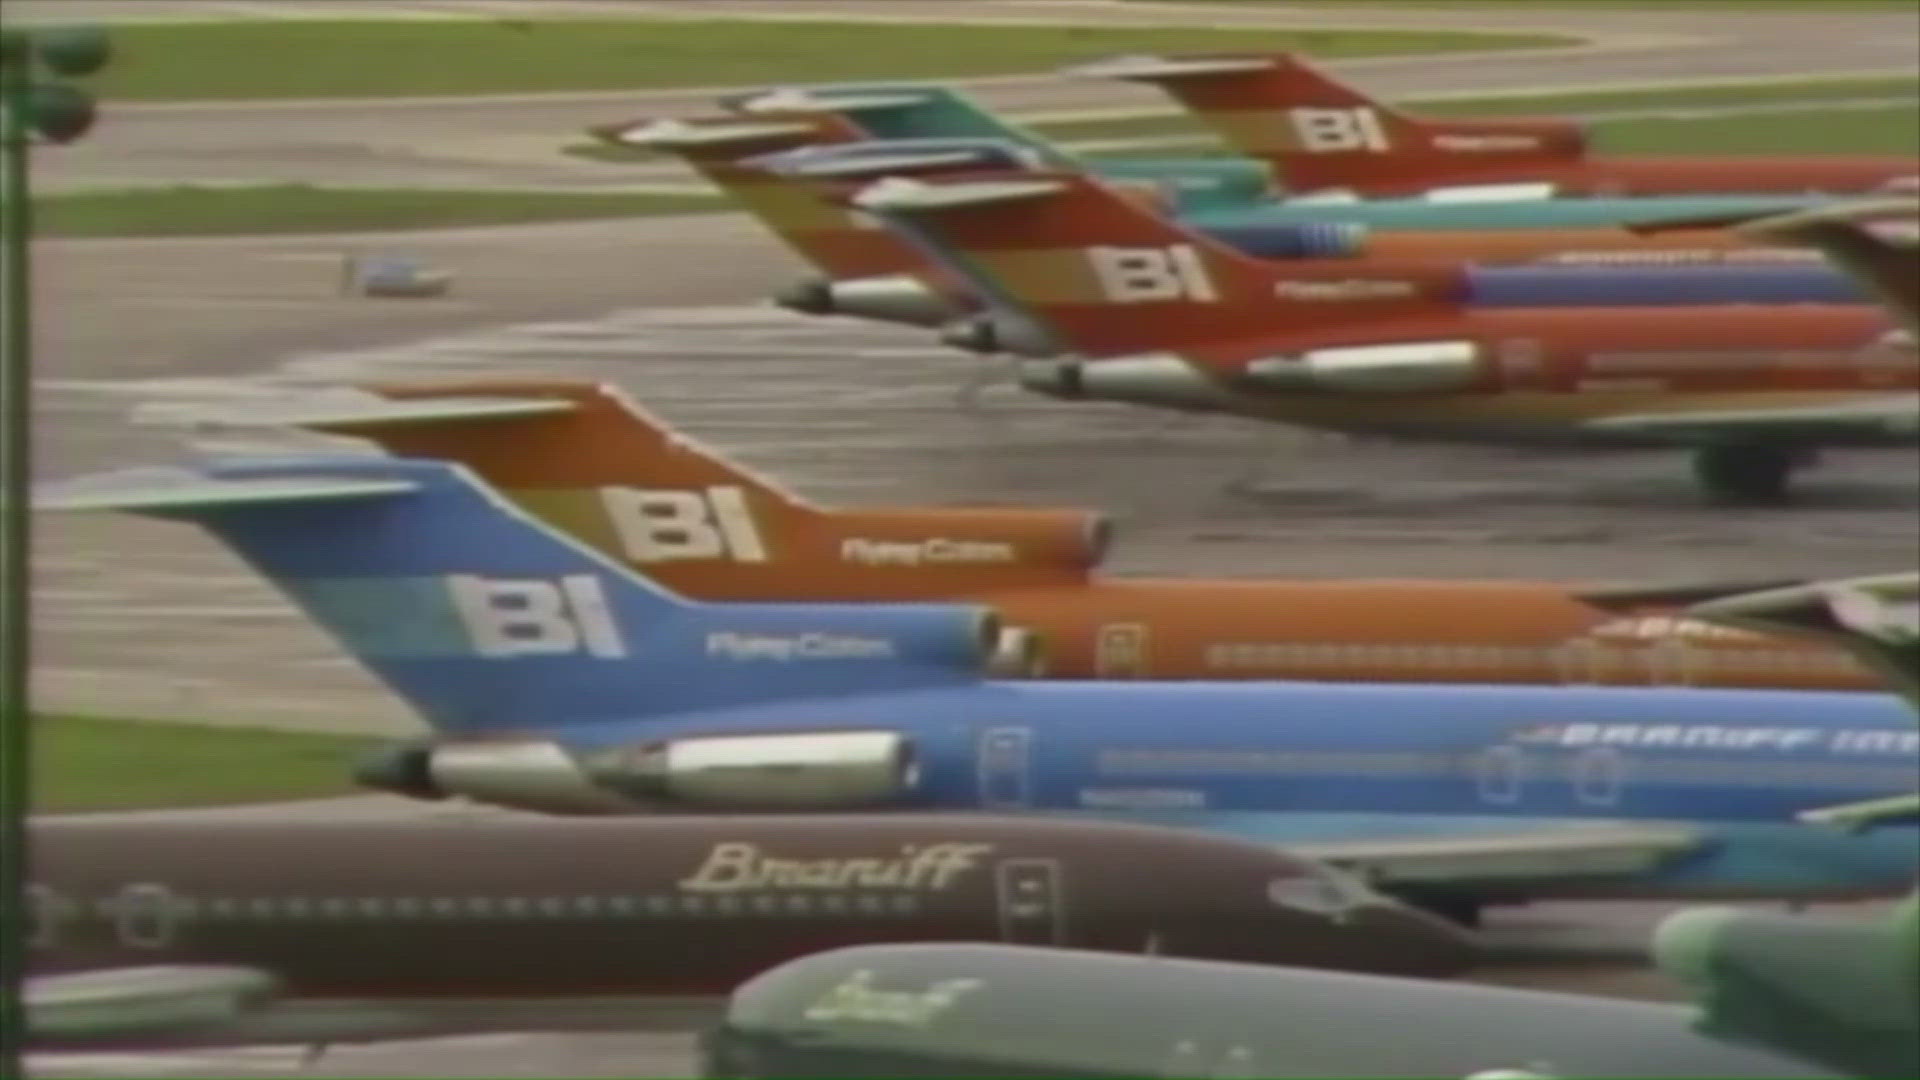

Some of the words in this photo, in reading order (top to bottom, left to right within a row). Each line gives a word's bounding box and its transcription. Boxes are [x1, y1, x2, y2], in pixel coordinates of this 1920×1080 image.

[1291, 107, 1389, 152] BI
[1088, 245, 1221, 302] BI
[601, 485, 767, 562] BI
[446, 573, 628, 659] BI
[678, 841, 994, 890] Braniff
